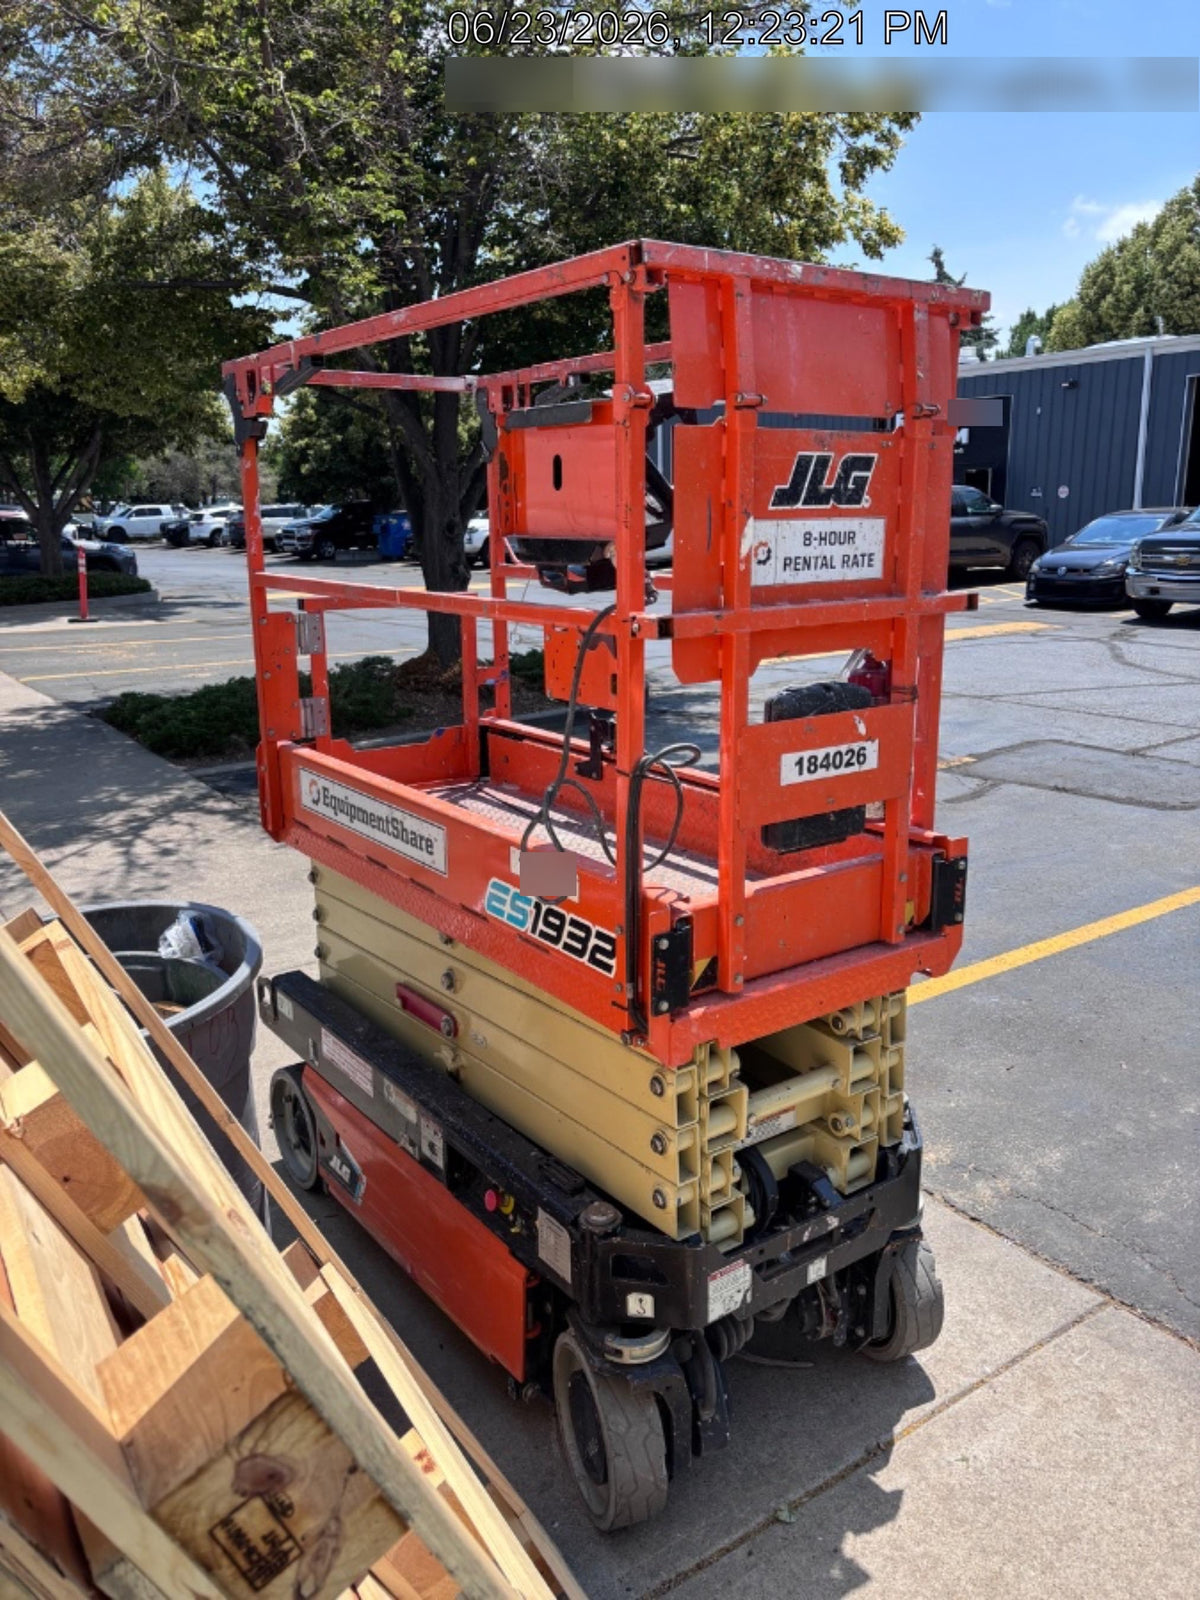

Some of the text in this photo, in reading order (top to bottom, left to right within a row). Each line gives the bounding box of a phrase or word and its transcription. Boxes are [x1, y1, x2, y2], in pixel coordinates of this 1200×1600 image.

[768, 452, 878, 510] JLG
[803, 531, 856, 547] 8-HOUR
[783, 552, 875, 572] RENTAL RATE
[794, 746, 867, 776] 184026
[321, 786, 435, 856] EquipmentShare
[484, 876, 617, 978] ES1932
